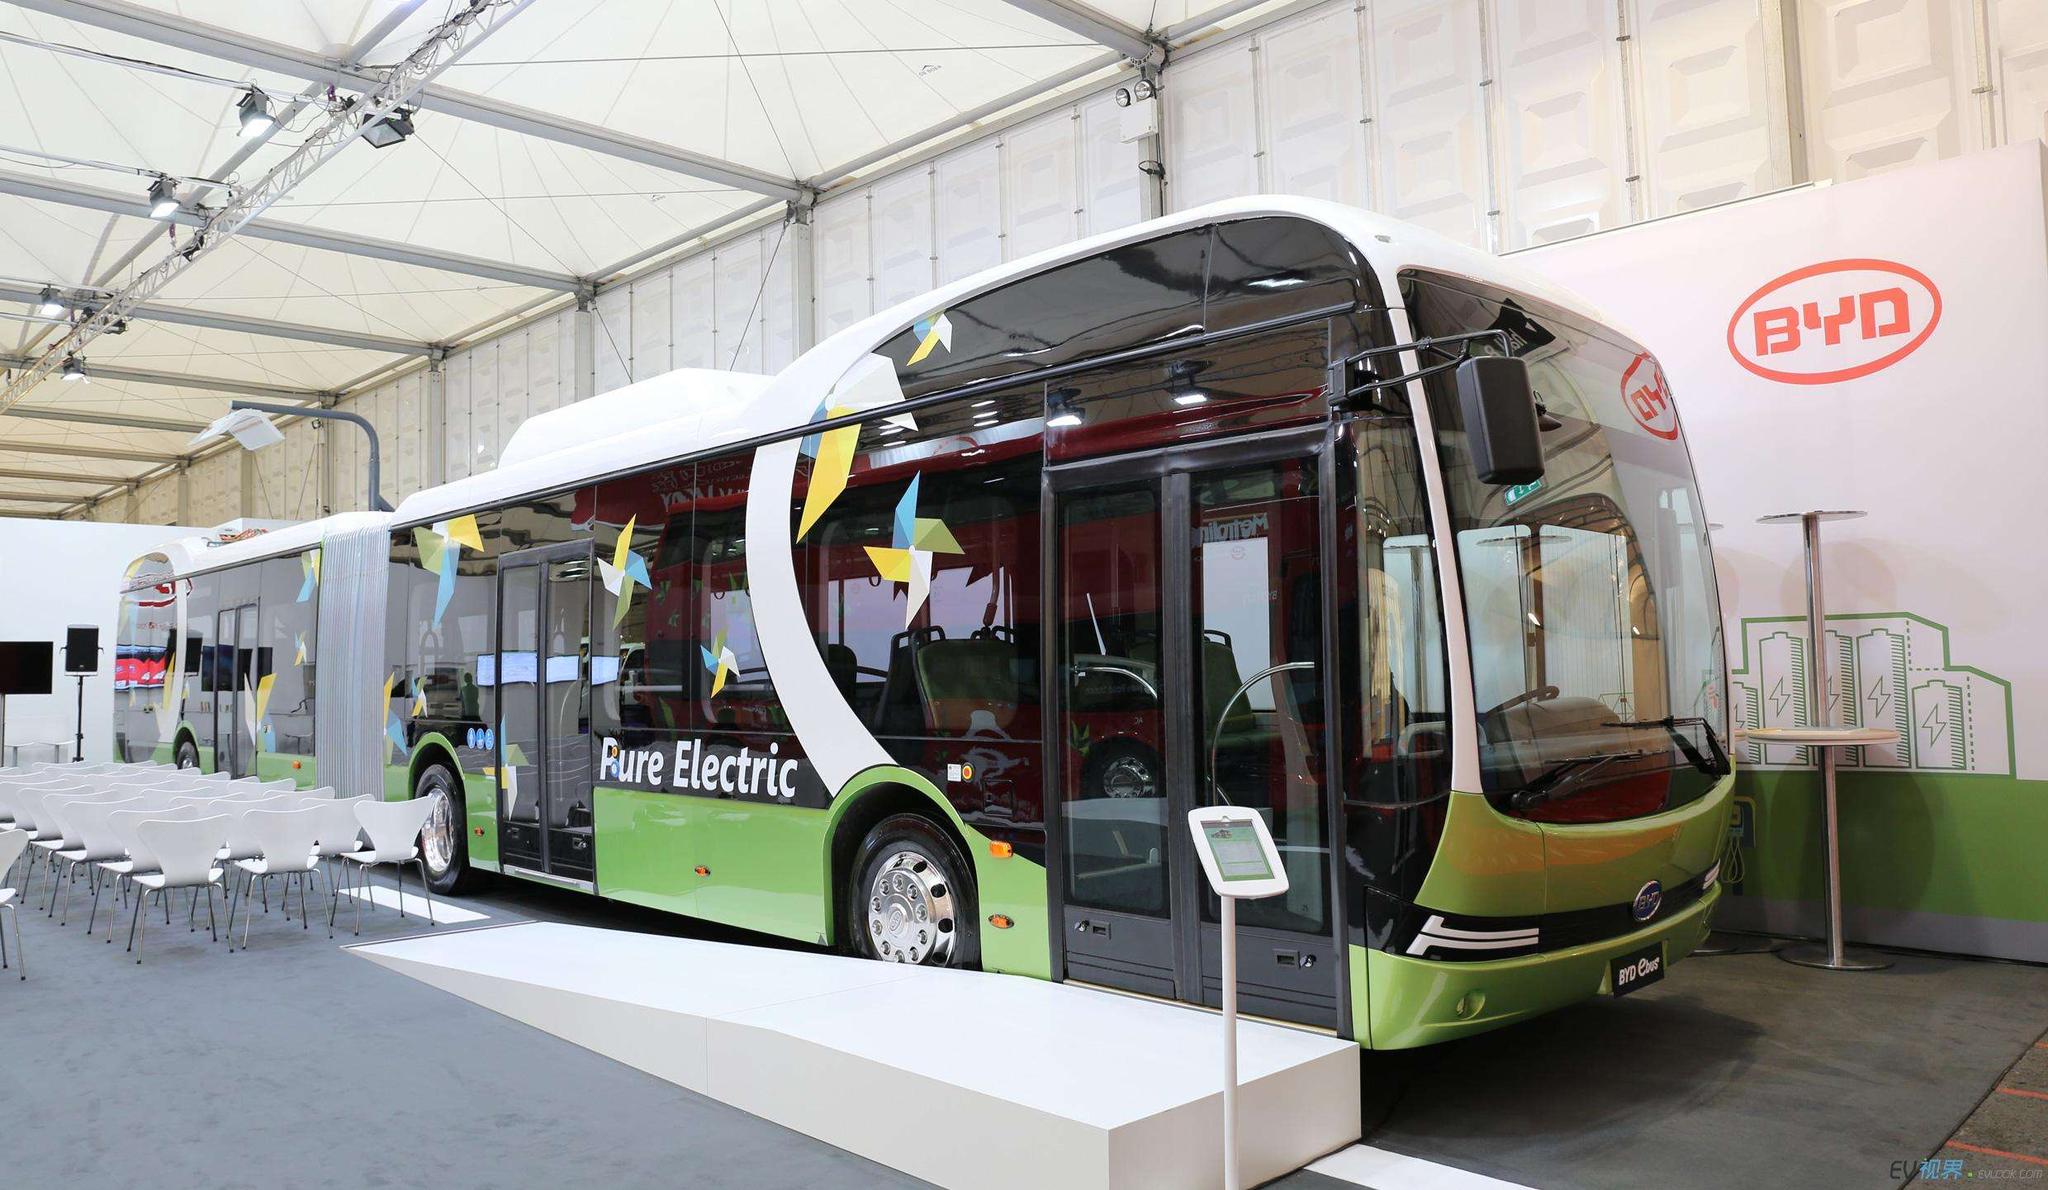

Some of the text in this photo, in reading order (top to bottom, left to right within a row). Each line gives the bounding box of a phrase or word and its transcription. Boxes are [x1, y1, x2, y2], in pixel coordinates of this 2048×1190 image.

[1753, 287, 1910, 357] BYD
[600, 736, 799, 798] Pure Electric
[1618, 964, 1636, 986] BYD
